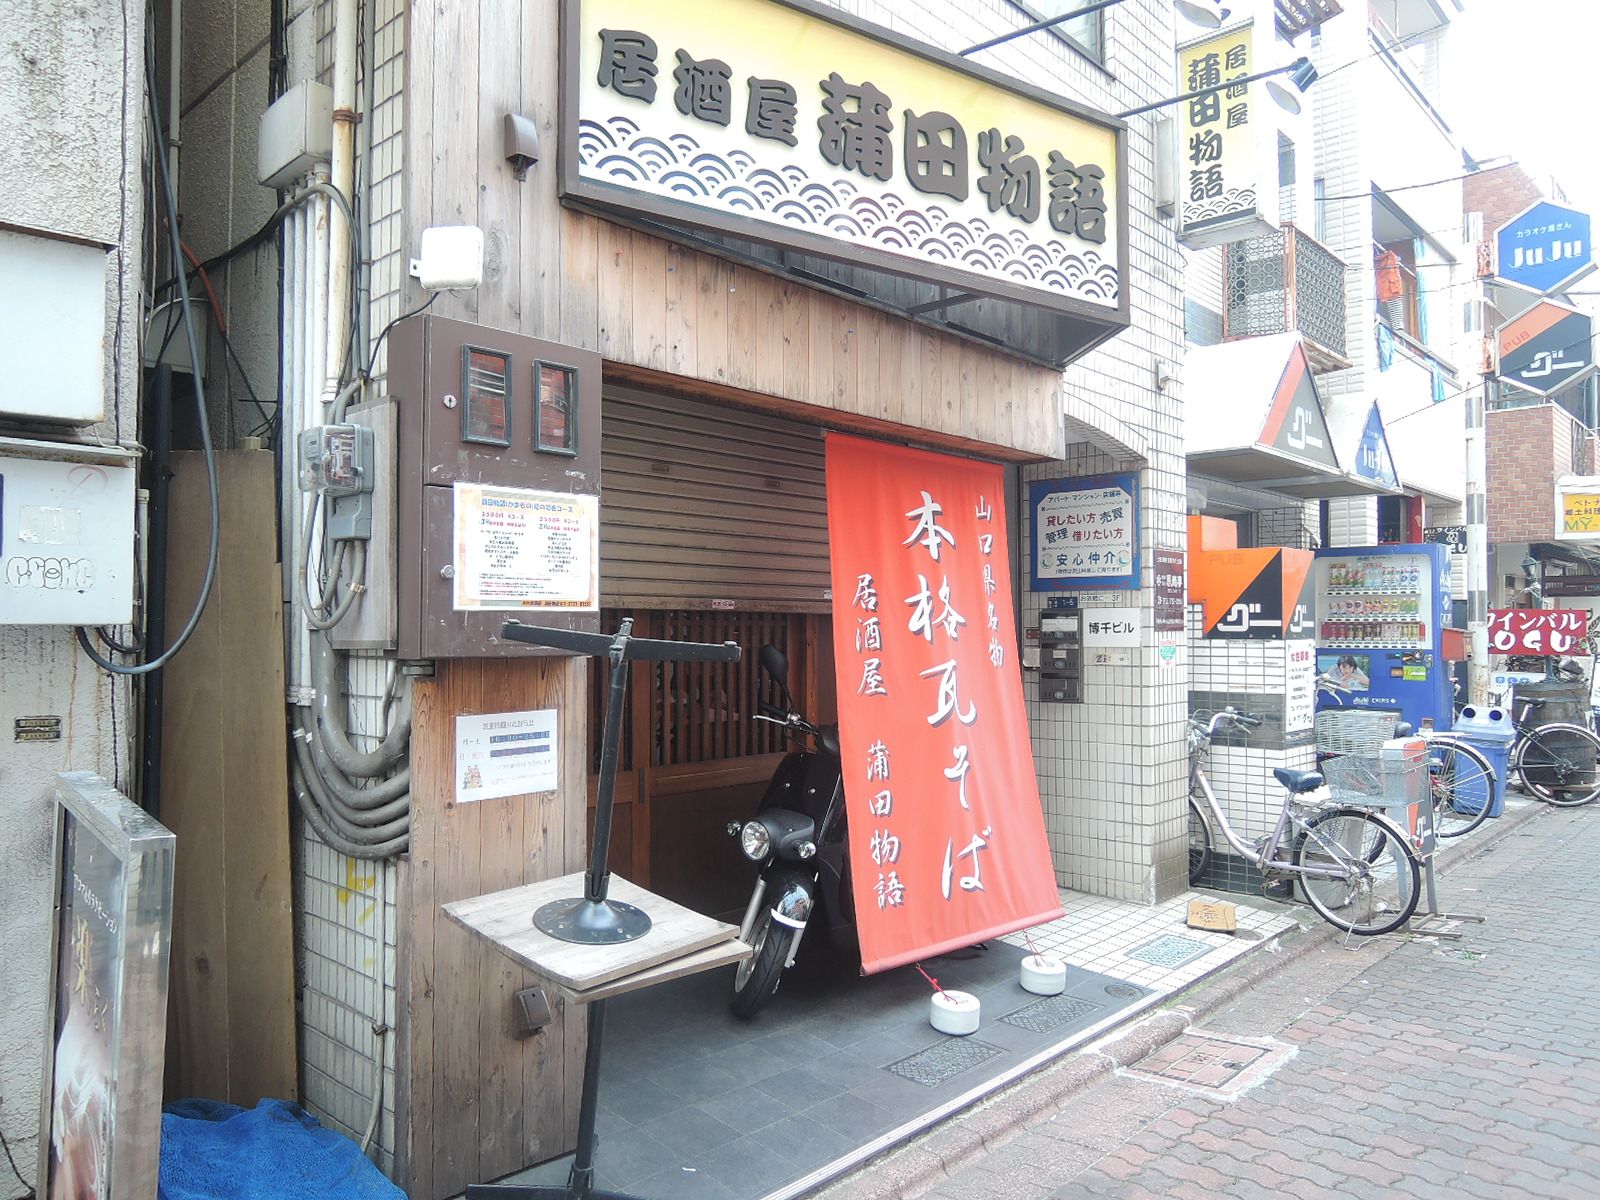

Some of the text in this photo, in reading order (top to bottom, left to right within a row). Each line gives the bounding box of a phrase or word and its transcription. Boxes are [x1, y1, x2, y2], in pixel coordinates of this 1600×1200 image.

[1224, 43, 1249, 130] 居酒屋
[597, 28, 1107, 244] 居酒屋 蒲田物語
[1188, 53, 1224, 203] 蒲田物語
[1516, 222, 1572, 239] カラオケ屋さん
[1508, 240, 1583, 269] JuJu
[1503, 331, 1530, 352] PUB
[1046, 507, 1125, 527] 貸したい方 売買
[1045, 527, 1124, 545] 管理 借りたい方
[1056, 551, 1117, 567] 安心仲介
[1208, 553, 1244, 566] PUB
[975, 495, 1005, 669] 山口県名物
[851, 573, 887, 697] 居酒屋
[1488, 630, 1571, 652] OGU
[902, 490, 992, 900] 本格瓦そば
[866, 739, 904, 909] 蒲田物語
